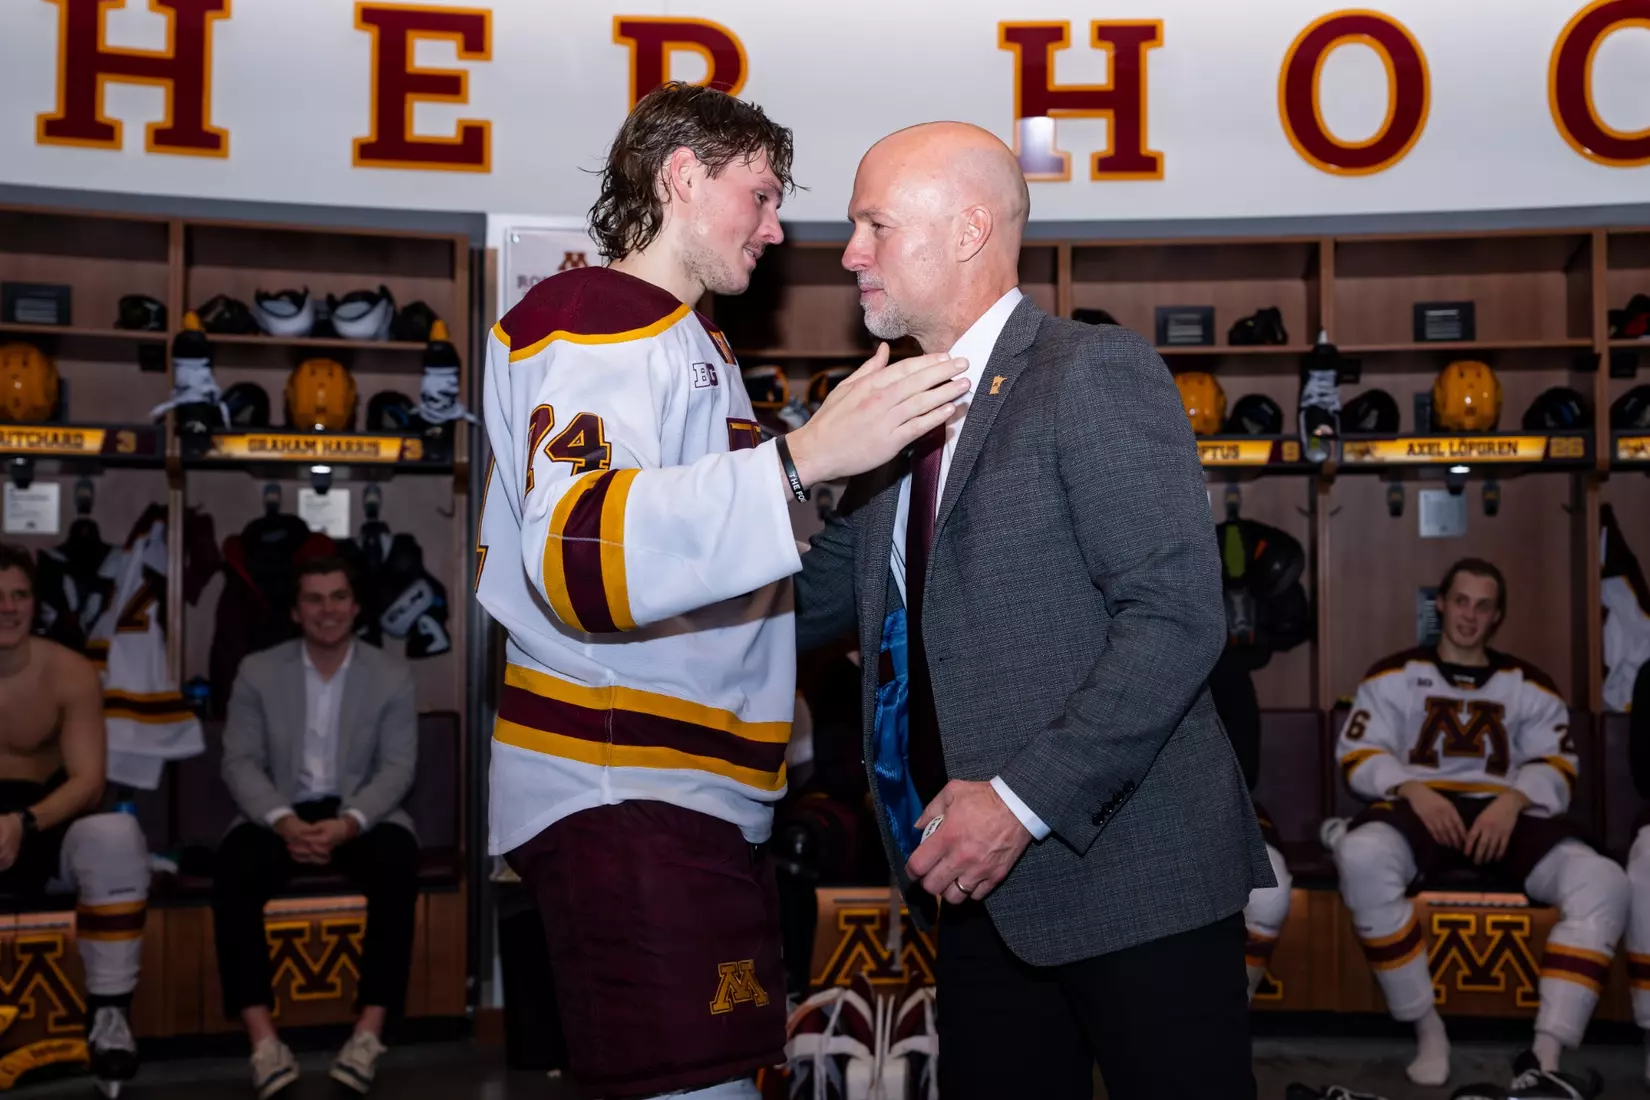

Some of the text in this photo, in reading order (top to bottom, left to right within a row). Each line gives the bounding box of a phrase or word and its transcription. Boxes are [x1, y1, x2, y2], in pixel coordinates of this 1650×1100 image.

[116, 430, 137, 453] 3
[248, 438, 380, 457] GRAHAM HARRIS
[1407, 441, 1445, 457] AXEL
[789, 470, 800, 490] THE
[1408, 696, 1510, 778] M
[1428, 913, 1541, 1007] M
[709, 959, 769, 1015] M
